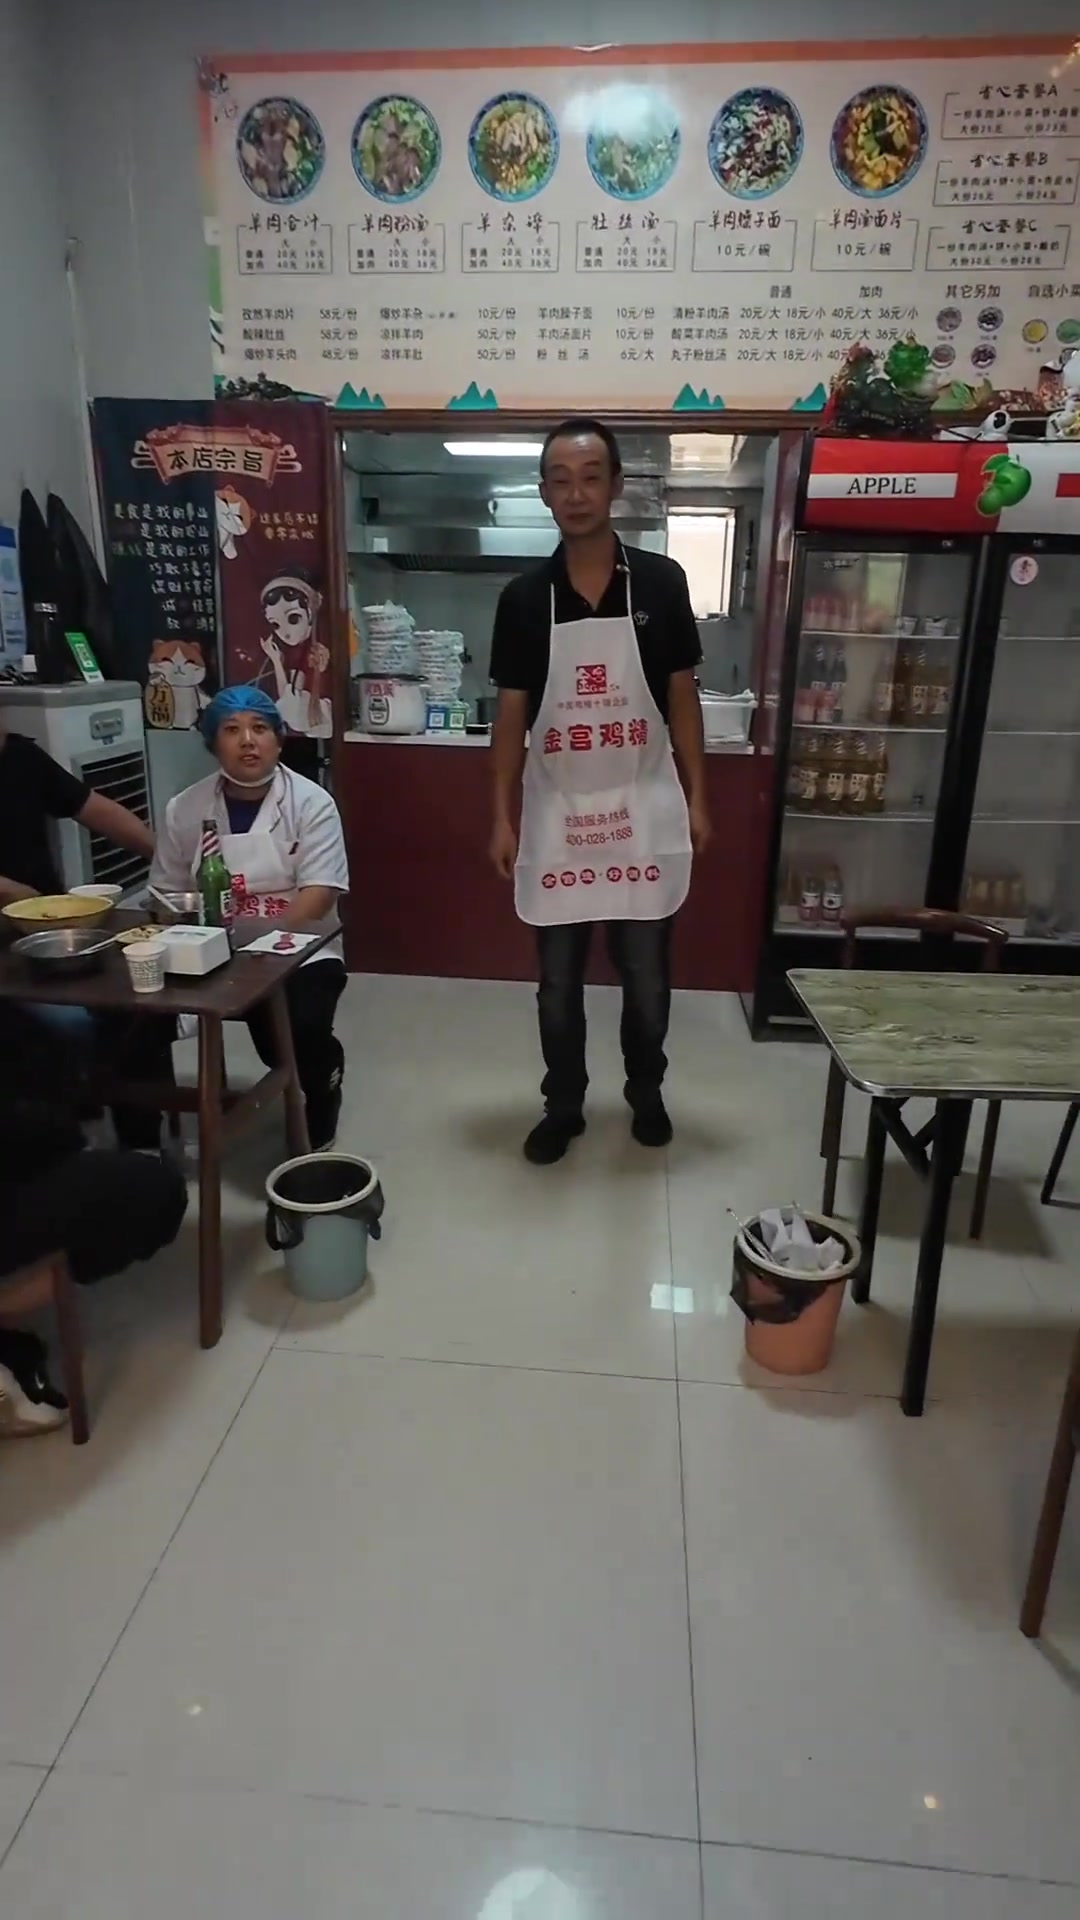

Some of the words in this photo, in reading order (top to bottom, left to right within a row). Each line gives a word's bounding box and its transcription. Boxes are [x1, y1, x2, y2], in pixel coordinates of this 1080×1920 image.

[717, 243, 772, 257] 10元/碗
[837, 242, 892, 257] 10元/碗
[769, 285, 792, 299] 普通
[859, 285, 883, 299] 加肉
[945, 284, 1001, 299] 其它另加
[242, 307, 294, 320] 孜然羊肉片
[320, 308, 358, 321] 58元/份
[379, 307, 424, 320] 爆炒羊杂
[478, 307, 516, 320] 10元/份
[616, 307, 655, 320] 10元/份
[740, 306, 781, 320] 20元/大
[786, 306, 826, 320] 18元/小
[831, 306, 872, 320] 40元/大
[878, 306, 919, 320] 36元/小
[321, 328, 358, 341] 58元/份
[380, 328, 423, 341] 凉拌羊肉
[477, 328, 516, 341] 50元/份
[537, 328, 592, 341] 羊肉汤面片
[616, 328, 654, 340] 10元/份
[671, 328, 728, 340] 酸菜羊肉汤
[738, 327, 778, 340] 20元/大
[785, 327, 824, 340] 18元/小
[829, 327, 870, 340] 40元/大
[322, 349, 359, 361] 48元/份
[381, 348, 423, 361] 凉拌羊肚
[477, 349, 516, 361] 50元/份
[620, 349, 655, 362] 6元/大
[671, 348, 727, 361] 丸子粉丝汤
[737, 348, 777, 361] 20元/大
[783, 348, 822, 361] 18元/小
[167, 447, 263, 473] 本店宗旨
[846, 476, 917, 495] APPLE
[162, 598, 215, 614] 诚经营
[543, 716, 649, 755] 金宫鸡精
[564, 807, 631, 828] 全国服务热线
